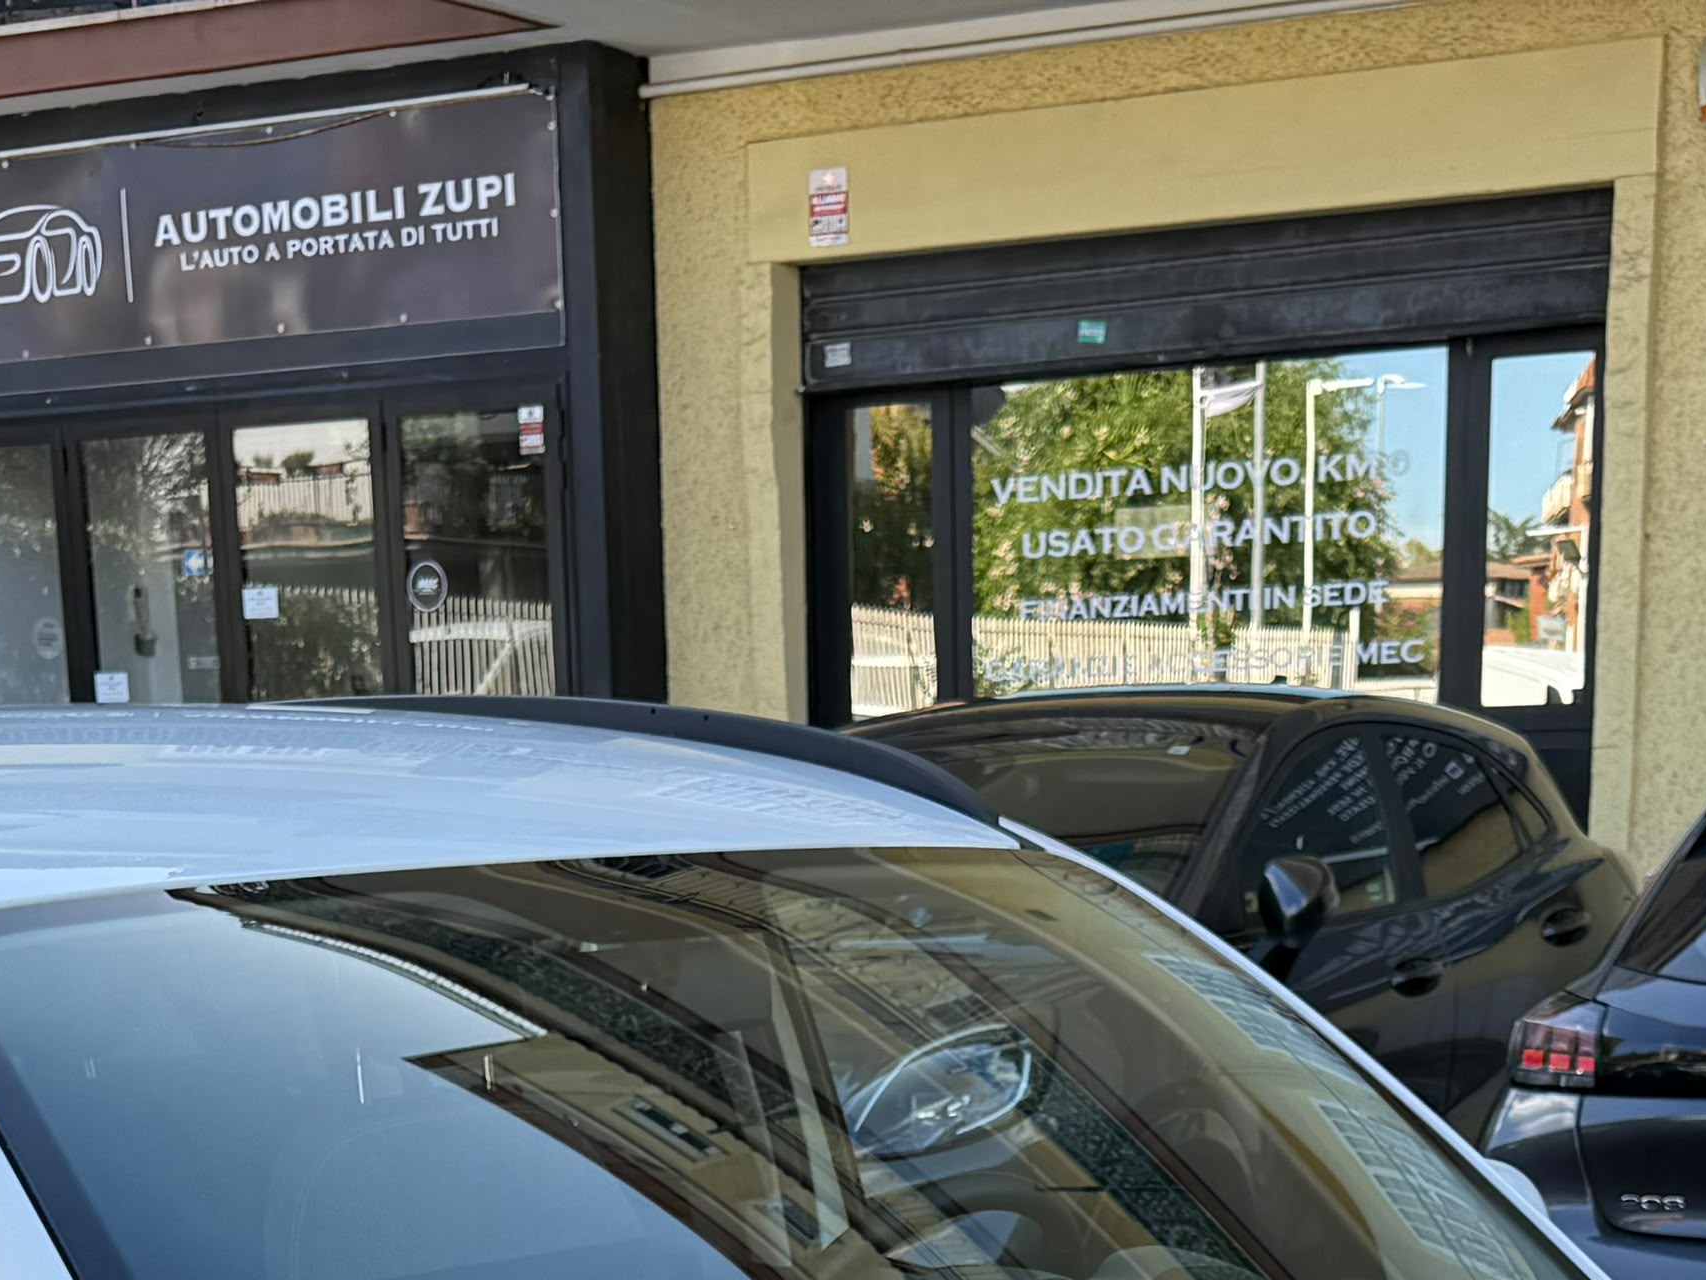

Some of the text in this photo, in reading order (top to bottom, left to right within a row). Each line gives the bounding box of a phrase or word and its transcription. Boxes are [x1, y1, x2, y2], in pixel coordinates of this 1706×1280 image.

[154, 172, 516, 247] AUTOMOBILI ZUPI
[179, 216, 499, 272] L'AUTO A PORTATA DI TUTTI
[991, 467, 1152, 505] VENDITA
[1022, 510, 1377, 559] USATO GARANTITO
[1019, 581, 1388, 622] FINANZIAMENTI IN SEDE
[1357, 638, 1425, 666] MEC
